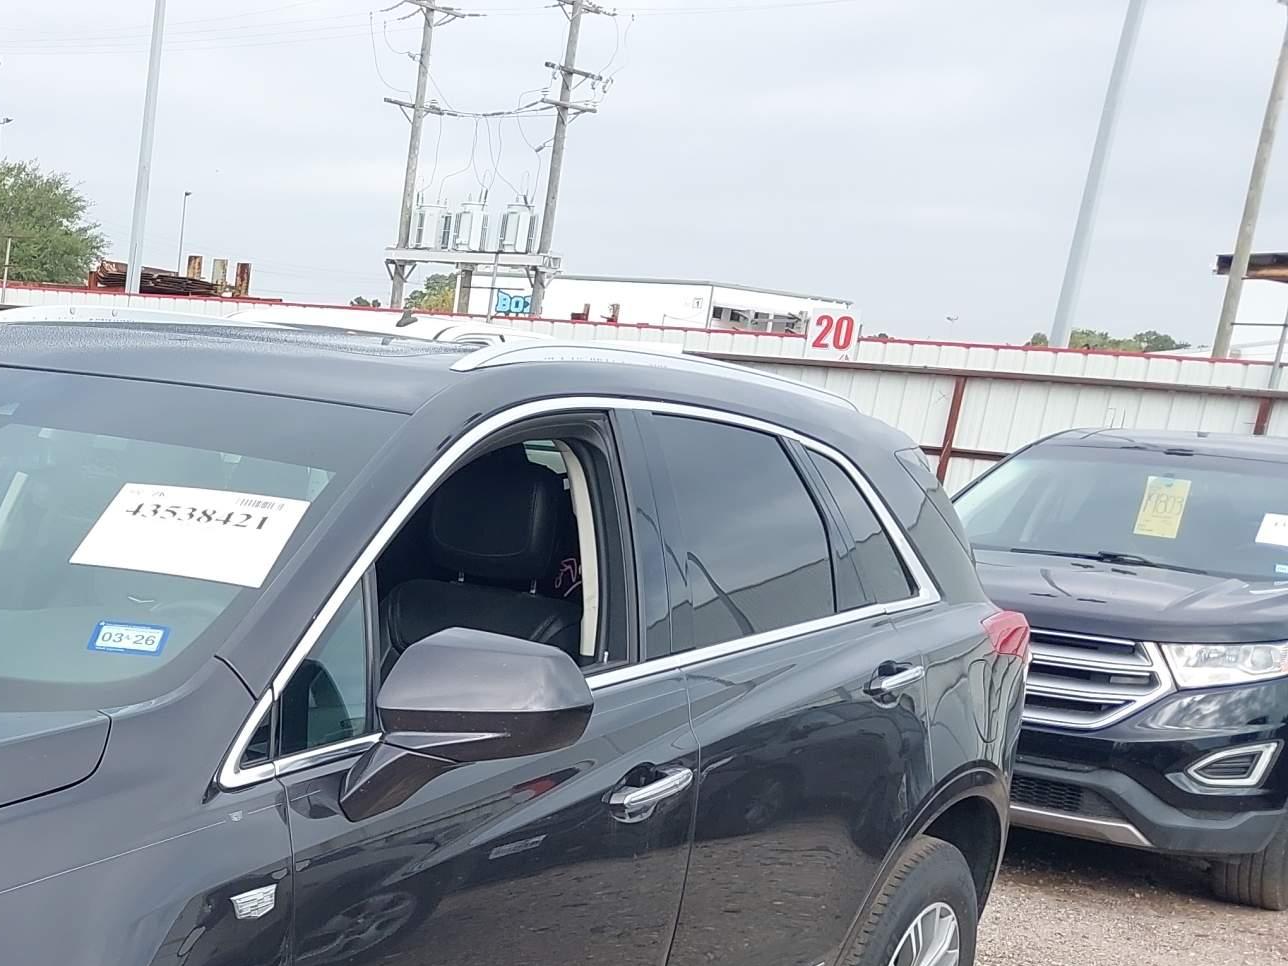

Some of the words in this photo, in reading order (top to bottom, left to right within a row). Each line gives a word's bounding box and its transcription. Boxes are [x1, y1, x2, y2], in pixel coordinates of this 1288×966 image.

[812, 314, 854, 350] 20
[125, 501, 269, 531] 43538421
[101, 631, 124, 643] 03
[133, 634, 157, 646] 26
